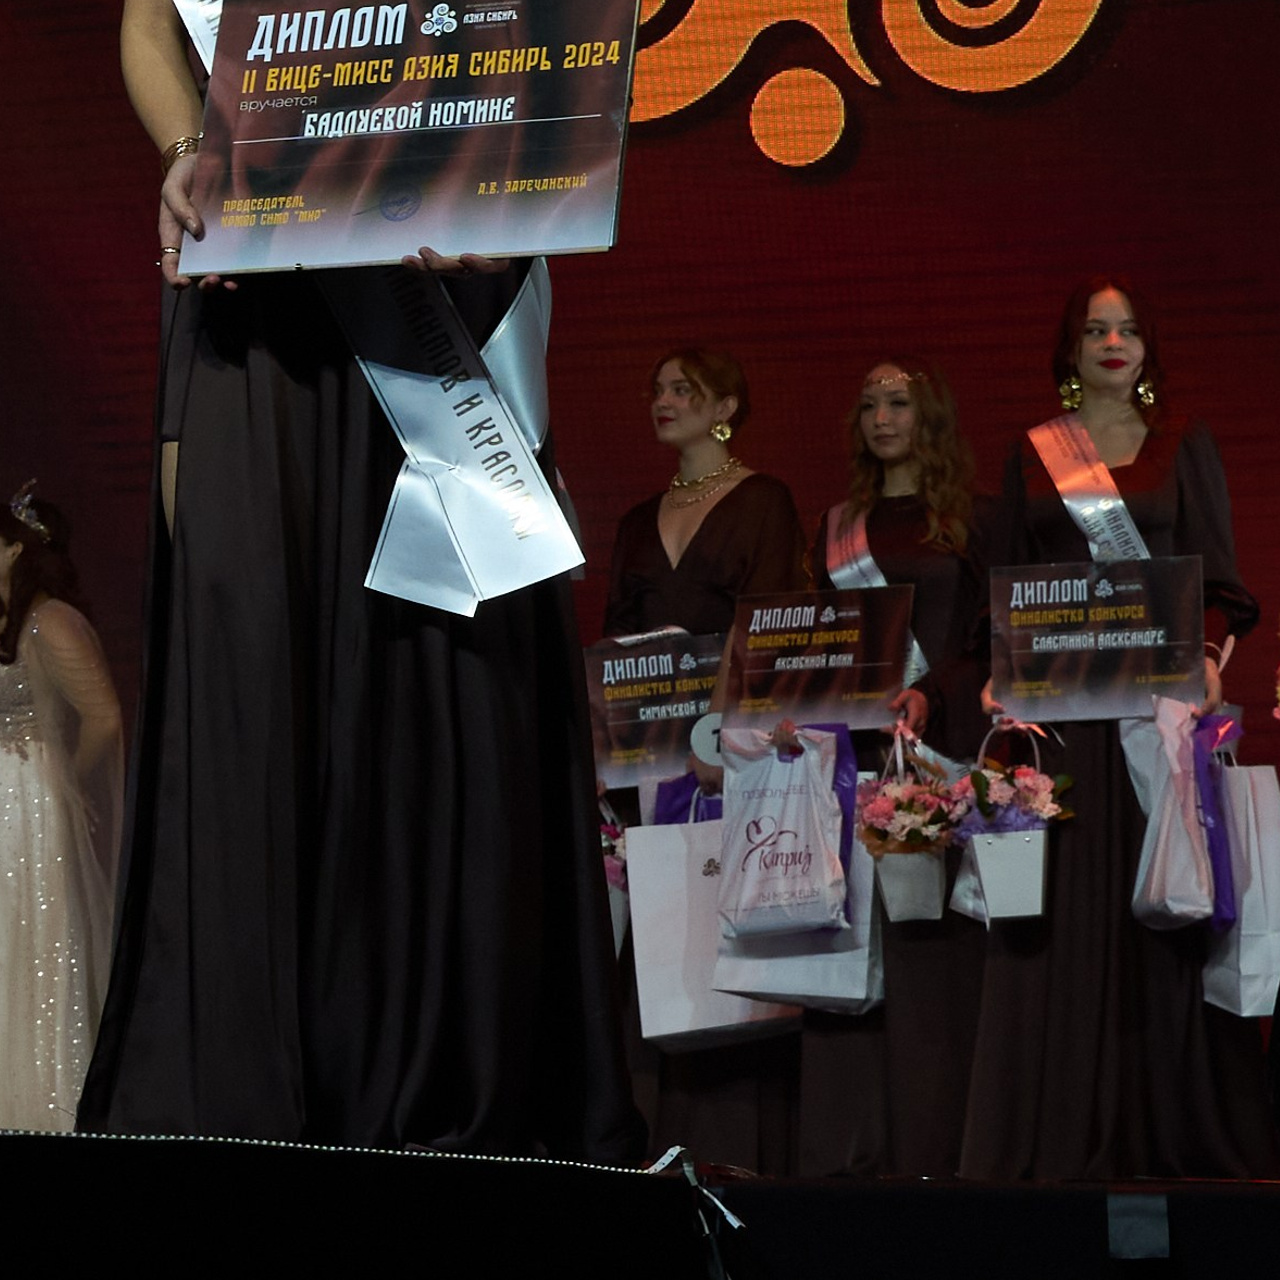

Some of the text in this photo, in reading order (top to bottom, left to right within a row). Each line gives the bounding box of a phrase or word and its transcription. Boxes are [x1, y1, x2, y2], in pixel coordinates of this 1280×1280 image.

[246, 3, 409, 62] ДИПЛОМ
[241, 40, 621, 96] II ВИЦЕ-МИСС АЗИЯ СИБИРЬ 2024
[239, 94, 318, 112] вручается
[303, 96, 516, 138] БАДЛУЕВОЙ НОМИНЕ
[504, 173, 588, 193] ЗАРЕЧАНСКИЙ
[223, 195, 305, 213] ПРЕДСЕДАТЕЛЬ
[452, 391, 485, 417] И
[1010, 578, 1088, 609] ДИПЛОМ
[748, 605, 817, 634] ДИПЛОМ
[1009, 604, 1146, 628] ФИНАЛИСТКА КОНКУРСА
[747, 629, 862, 650] ФИНАЛИСТКА КОНКУРСА
[1097, 628, 1165, 650] АЛЕКСАНДРЕ
[602, 653, 674, 685] ДИПЛОМ
[603, 676, 719, 702] ФИНАЛИСТКА КОНКУР
